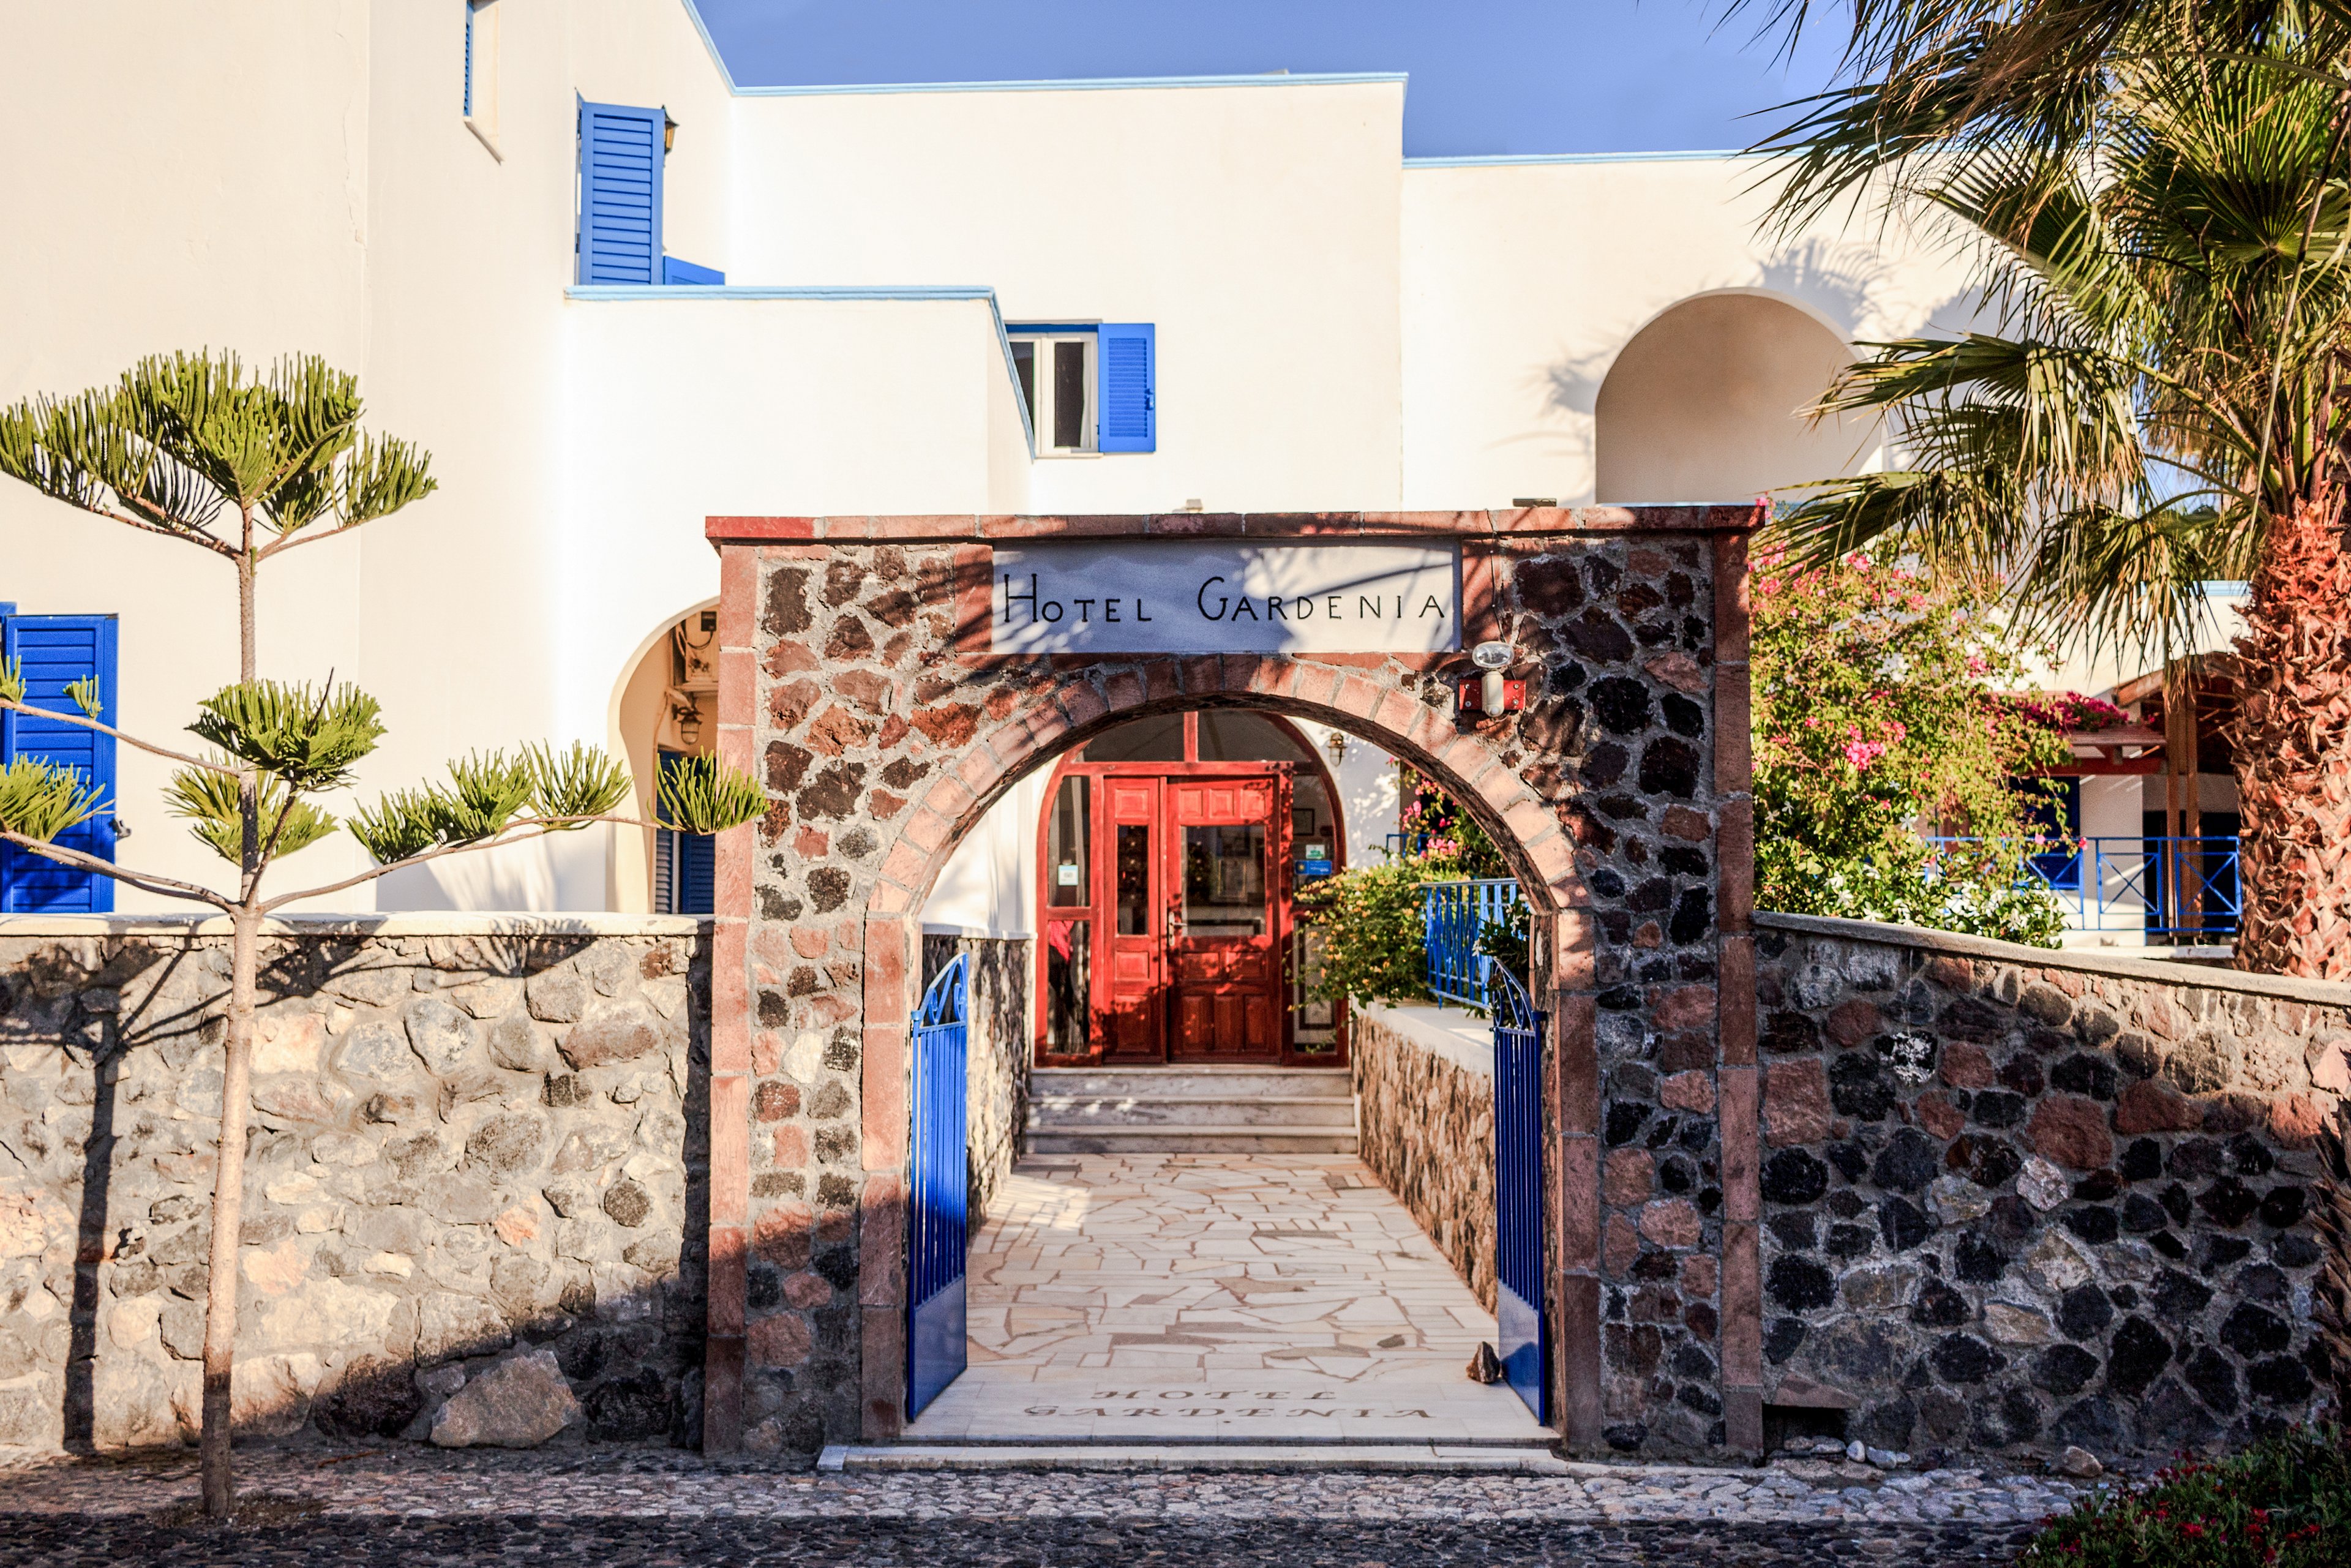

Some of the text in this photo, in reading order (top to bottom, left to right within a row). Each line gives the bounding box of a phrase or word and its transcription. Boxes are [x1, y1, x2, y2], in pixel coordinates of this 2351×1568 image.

[1004, 574, 1445, 623] HOTEL GARDENIA
[1091, 1389, 1337, 1400] HOTEL
[1024, 1406, 1434, 1417] GARDENIA
